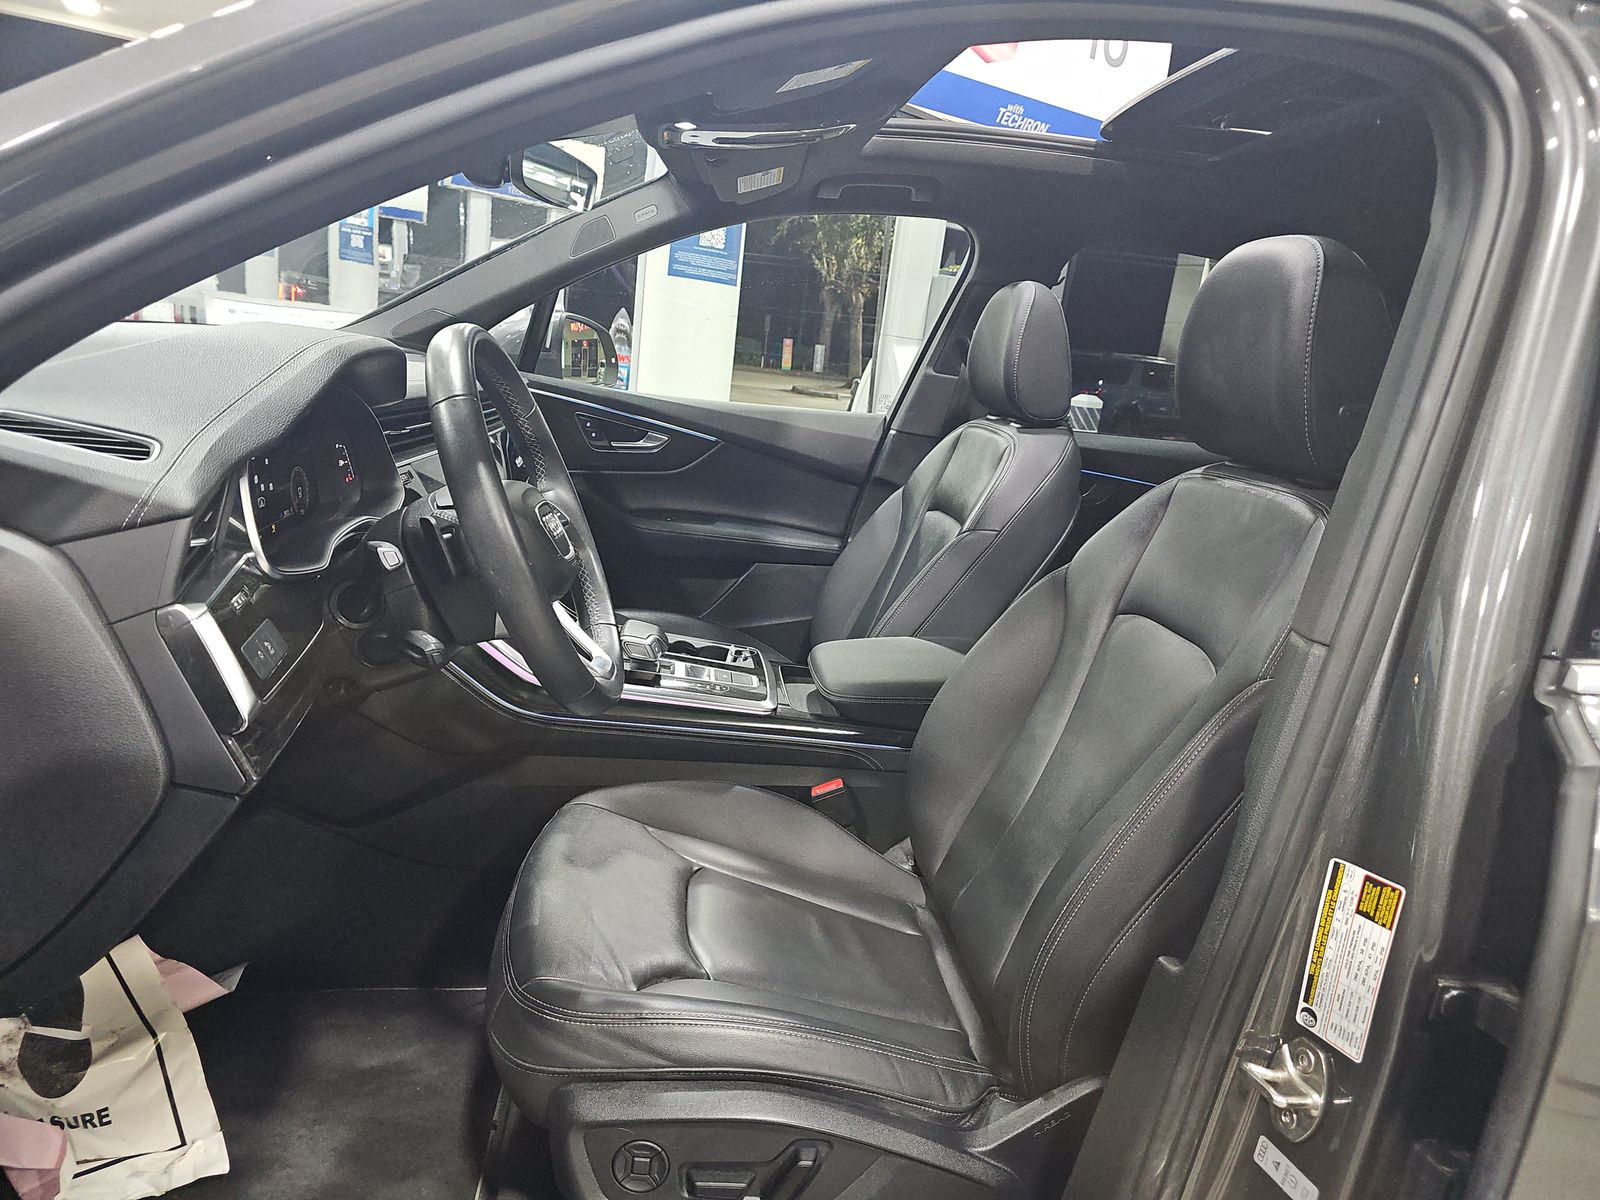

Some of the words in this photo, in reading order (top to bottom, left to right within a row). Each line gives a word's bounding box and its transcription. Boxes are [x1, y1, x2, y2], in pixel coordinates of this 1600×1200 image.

[1006, 103, 1025, 115] with
[996, 107, 1050, 133] TECHRON
[1327, 908, 1333, 917] ET
[1329, 900, 1335, 909] LE
[1314, 925, 1324, 951] LOADING
[1319, 888, 1333, 927] INFORMATION
[37, 1106, 113, 1131] SURE
